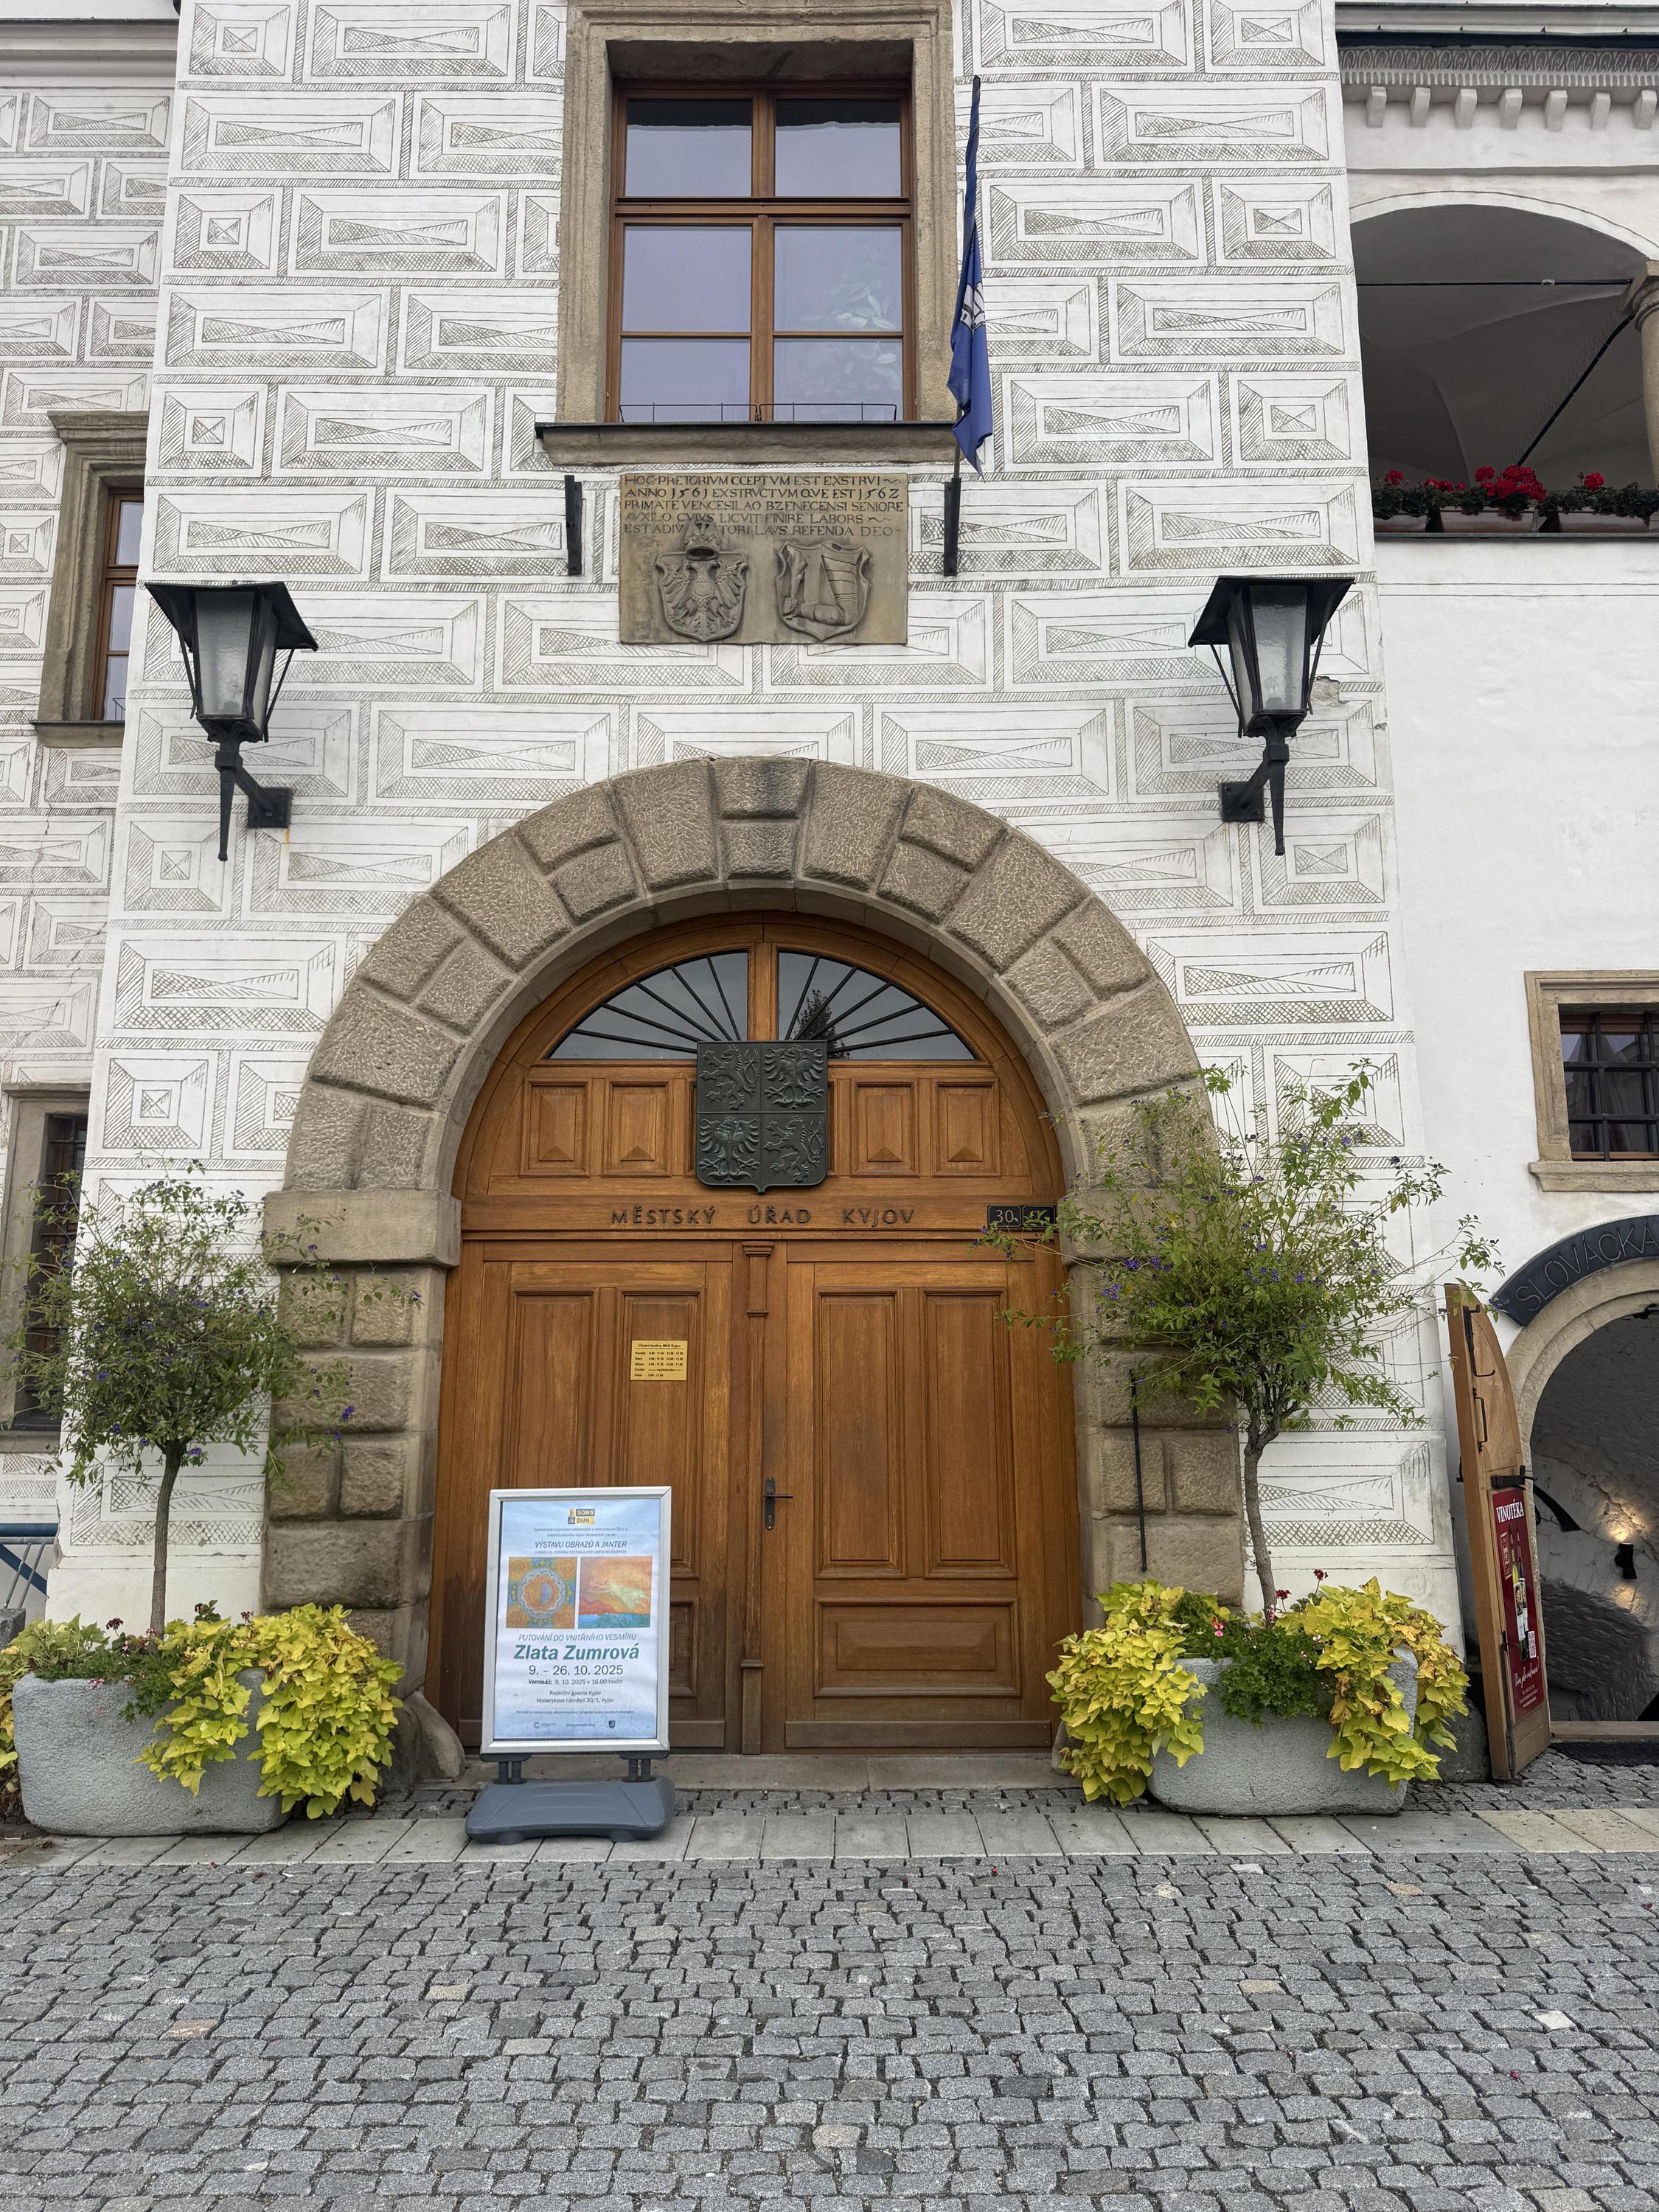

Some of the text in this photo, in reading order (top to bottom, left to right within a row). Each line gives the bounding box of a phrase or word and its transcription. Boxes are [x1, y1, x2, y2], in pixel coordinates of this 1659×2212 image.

[658, 476, 728, 485] PRETORIVM
[793, 476, 820, 485] EST
[824, 476, 880, 486] EXSTRVI
[625, 488, 666, 498] ANNO
[832, 489, 855, 498] EST
[625, 501, 678, 510] PRIMATE
[852, 502, 903, 512] SENIORE
[810, 514, 863, 524] LABORS
[625, 524, 651, 534] EST
[755, 526, 787, 535] LAVS
[793, 526, 854, 536] REFENDA
[860, 526, 893, 537] DEO
[611, 1204, 914, 1228] MĚSTSKÝ ÚŘAD KYJOV
[995, 1209, 1014, 1223] 30
[1515, 1219, 1659, 1312] SLOVÁCKÁ
[1496, 1498, 1525, 1523] VINOTÉKA
[535, 1540, 564, 1548] VÝSTAVU
[518, 1632, 553, 1641] PUTOVÁNÍ
[566, 1632, 604, 1641] VNITŘNÍHO
[605, 1632, 637, 1641] VESMÍRU
[513, 1642, 640, 1660] Zlata Zumrová
[529, 1665, 539, 1675] 9.
[553, 1665, 570, 1675] 26.
[574, 1665, 591, 1675] 10.
[594, 1665, 624, 1675] 2025
